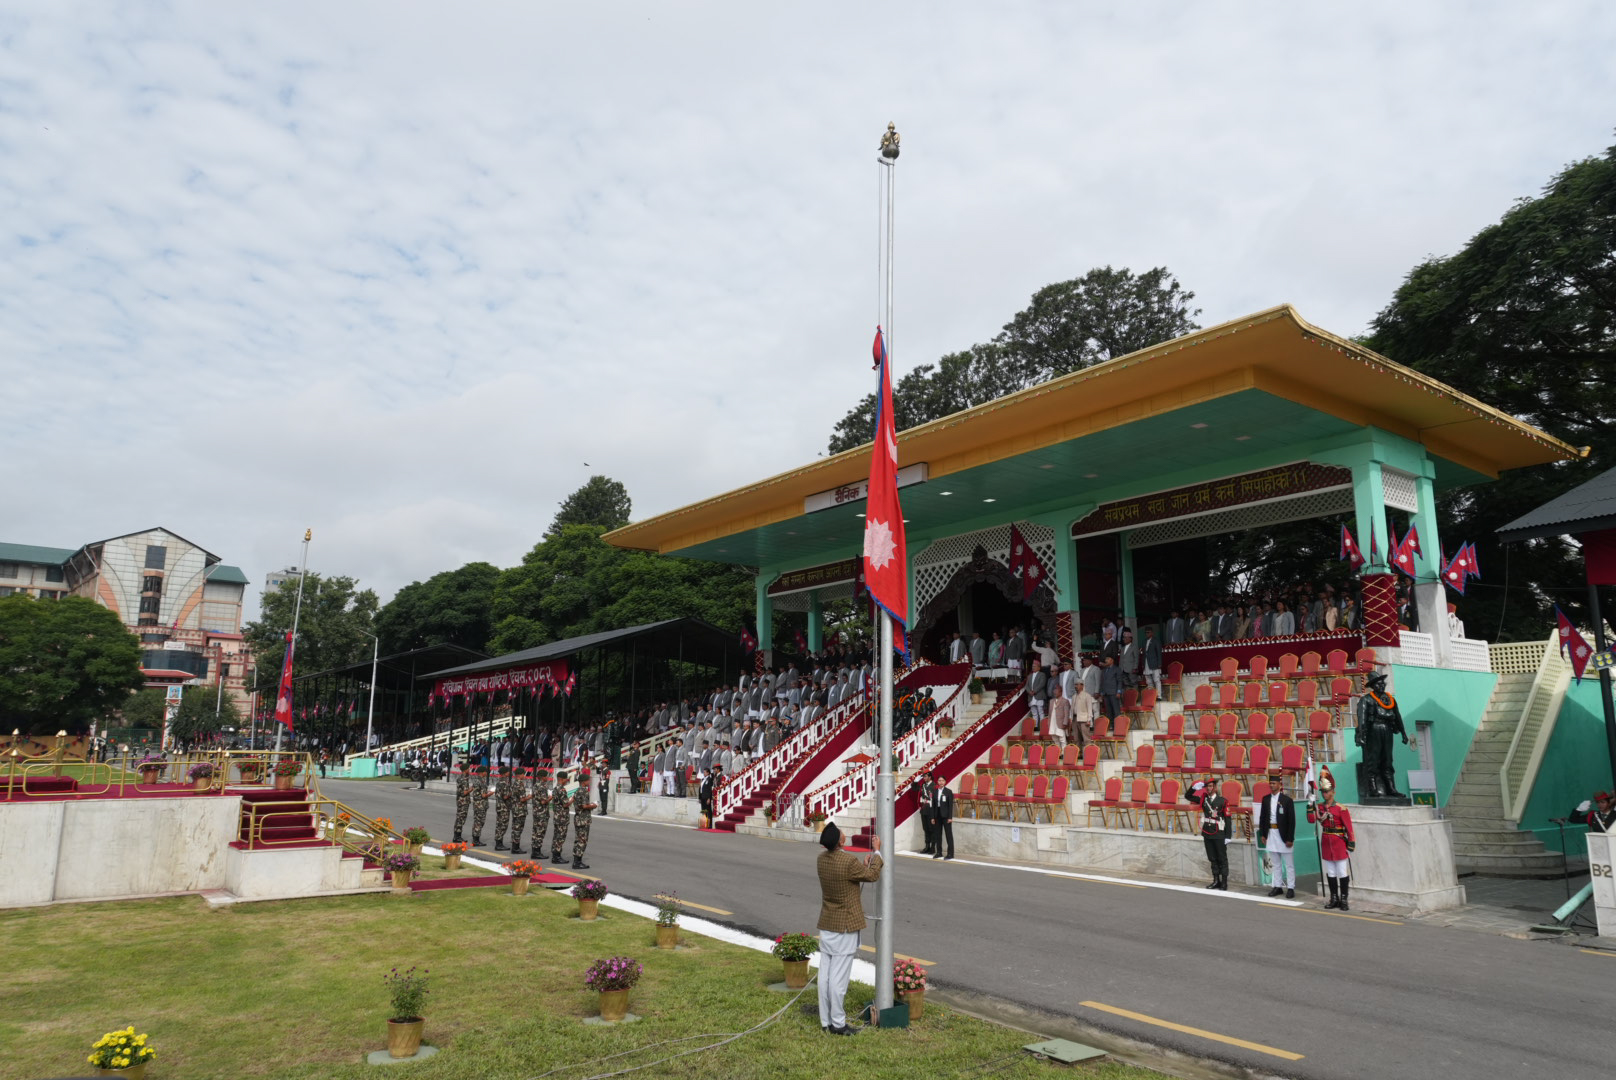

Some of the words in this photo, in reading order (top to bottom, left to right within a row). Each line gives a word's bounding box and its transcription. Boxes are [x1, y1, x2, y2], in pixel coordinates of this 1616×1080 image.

[835, 487, 860, 503] सैनिक
[1104, 502, 1140, 522] सर्वप्रथम
[1148, 498, 1165, 515] सदा
[1171, 493, 1191, 510] जान
[1193, 484, 1210, 505] धर्म
[1215, 478, 1235, 501] कर्म
[1240, 467, 1290, 496] सिपाहीको
